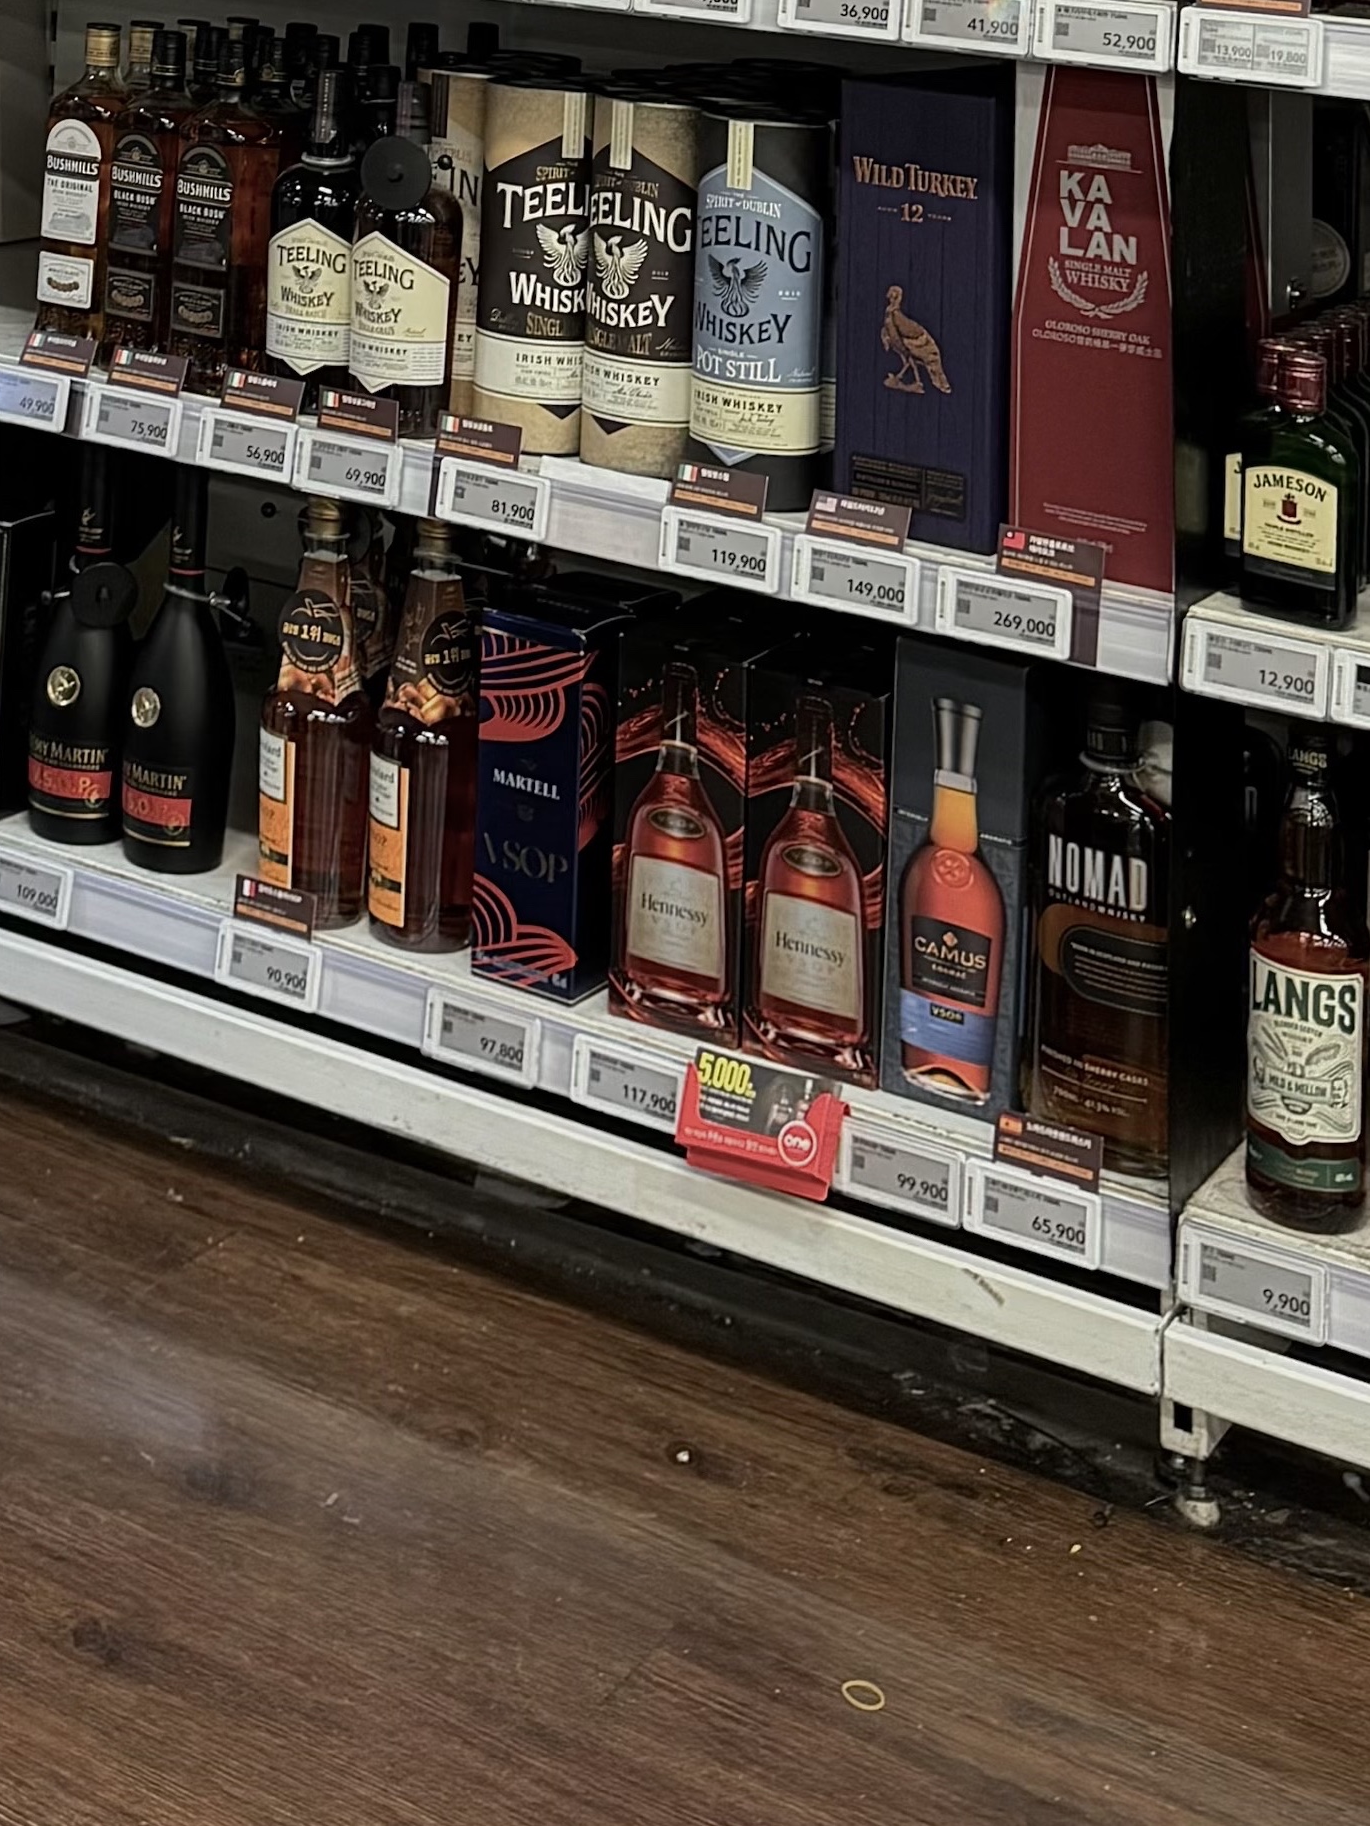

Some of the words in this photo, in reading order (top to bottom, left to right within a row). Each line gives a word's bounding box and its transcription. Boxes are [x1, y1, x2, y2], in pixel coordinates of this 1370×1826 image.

[839, 3, 889, 22] 36,900
[966, 17, 1020, 36] 41,900
[1102, 32, 1157, 52] 52,900
[1215, 43, 1252, 59] 13,900
[46, 154, 100, 176] BUSHMILLS
[111, 165, 162, 189] BUSHMILLS
[535, 164, 570, 181] SPIRIT
[852, 155, 904, 189] WILD
[904, 162, 979, 200] TURKEY
[113, 189, 135, 202] BLACK
[705, 194, 735, 210] SPIRIT
[742, 198, 782, 219] DUBLIN
[276, 244, 348, 274] TEELING
[1063, 259, 1101, 275] SINGLE
[1102, 265, 1133, 278] MALT
[353, 258, 416, 291] TEELING
[1063, 269, 1132, 294] WHISKY
[1044, 319, 1091, 337] OLOROSO
[1091, 325, 1128, 343] SHERRY
[695, 343, 723, 372] POT
[725, 353, 782, 384] STILL
[19, 395, 56, 416] 49,900
[721, 395, 784, 415] WHISKEY
[130, 419, 168, 441] 75,900
[244, 444, 286, 467] 56,900
[344, 466, 388, 489] 69,900
[1252, 472, 1328, 504] JAMESON
[710, 548, 768, 575] 119,900
[845, 575, 907, 606] 149,000
[300, 622, 322, 644] 1위
[992, 609, 1057, 639] 269,000
[1258, 668, 1315, 696] 12,900
[51, 740, 109, 766] MARTIN
[492, 767, 561, 801] MARTELL
[1047, 833, 1149, 913] NOMAD
[16, 882, 58, 911] 109,000
[640, 891, 710, 928] Hennessy
[775, 930, 846, 969] Hennessy
[914, 935, 988, 971] CAMUS
[266, 965, 308, 992] 90,900
[1251, 958, 1357, 1037] LANGS
[479, 1039, 526, 1068] 97,800
[621, 1082, 677, 1114] 117,900
[783, 1134, 812, 1153] one
[896, 1172, 950, 1204] 99,900
[1031, 1214, 1087, 1246] 65,900
[1261, 1287, 1311, 1319] 9,900
